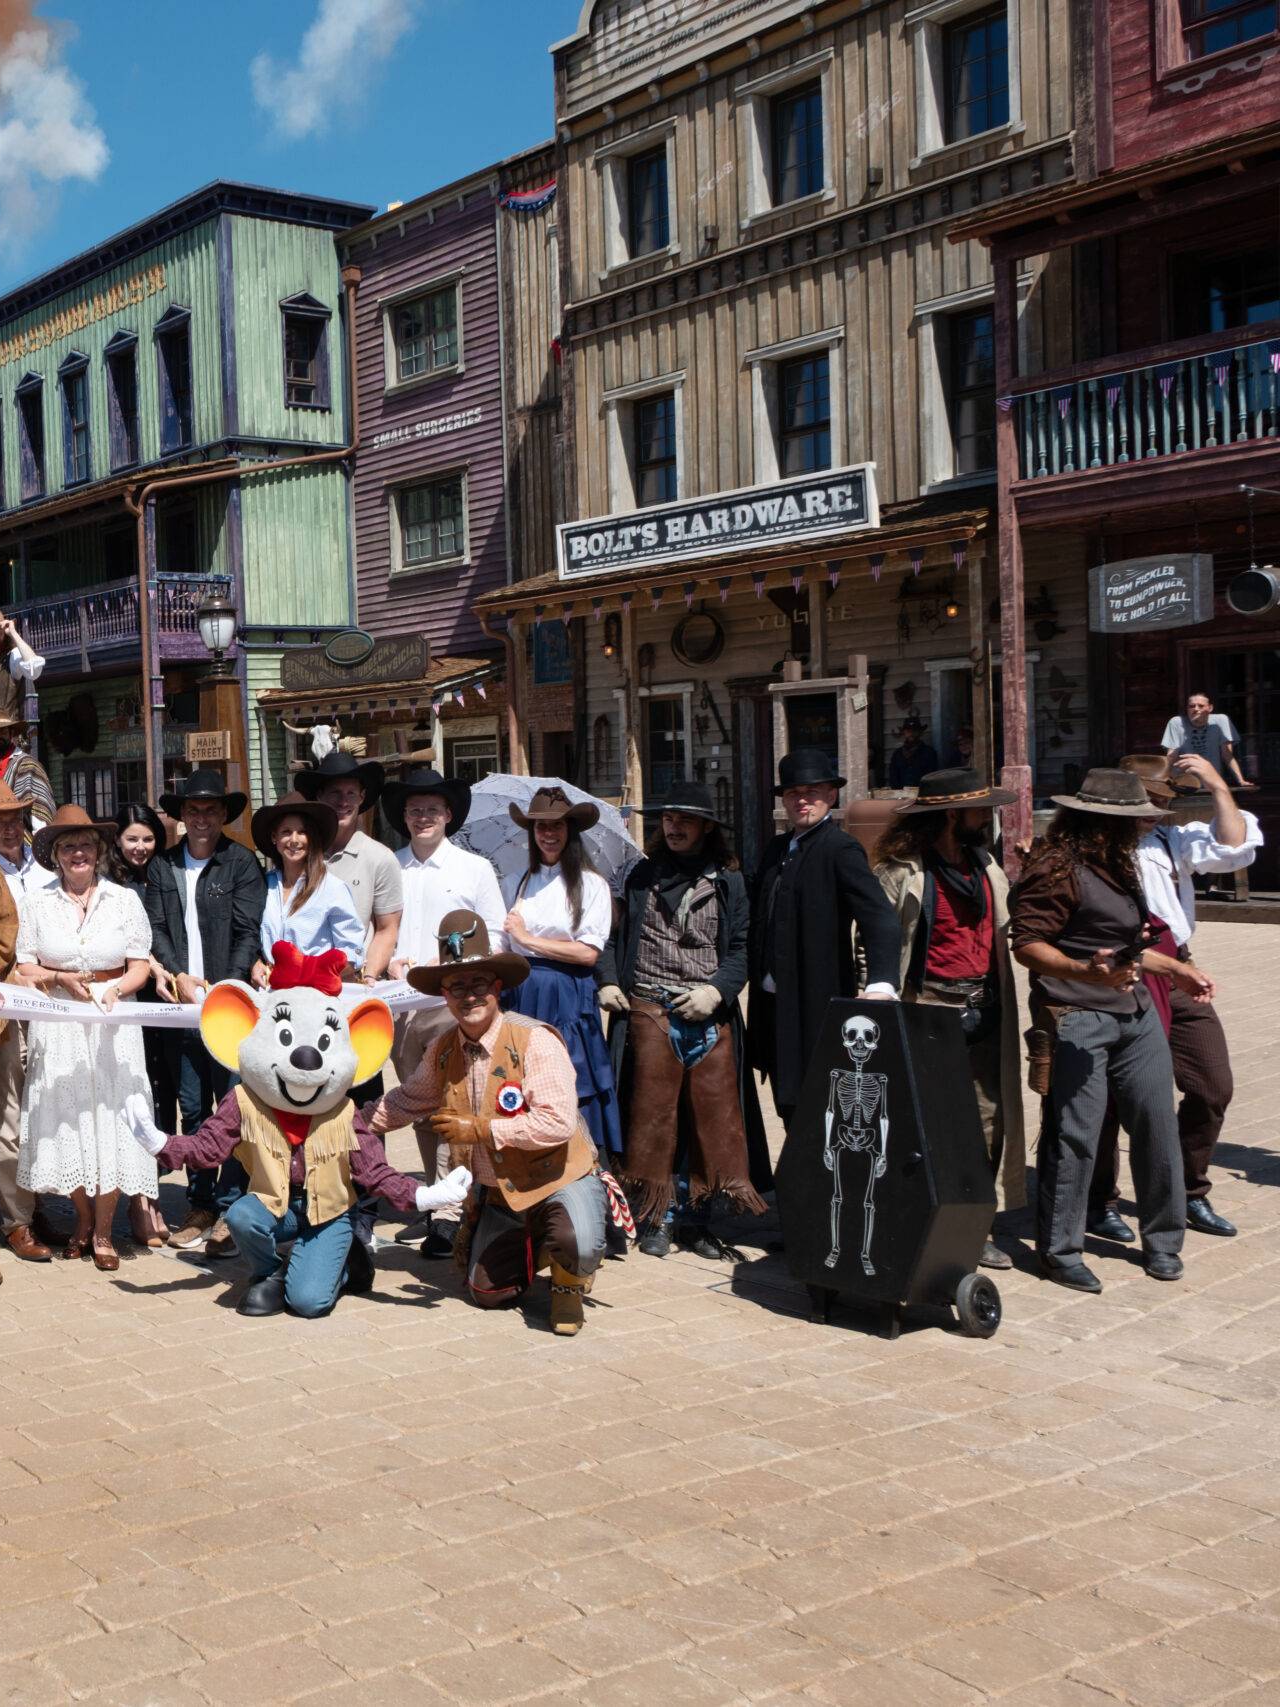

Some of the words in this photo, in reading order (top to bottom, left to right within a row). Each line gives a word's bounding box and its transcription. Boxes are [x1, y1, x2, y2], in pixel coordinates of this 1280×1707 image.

[373, 426, 411, 449] SMALL
[415, 407, 482, 436] SURGERIES
[569, 521, 659, 561] BOLT'S
[664, 483, 859, 543] HARDWARE.
[1106, 581, 1133, 596] FROM
[1135, 566, 1175, 588] PICKLES
[1110, 600, 1121, 609] TO
[1112, 612, 1128, 622] WE
[1131, 602, 1155, 620] HOLD
[1157, 596, 1167, 608] IT
[1169, 592, 1191, 606] ALL.
[191, 747, 222, 759] STREET
[196, 737, 217, 749] MAIN
[13, 997, 71, 1013] RIVERSIDE
